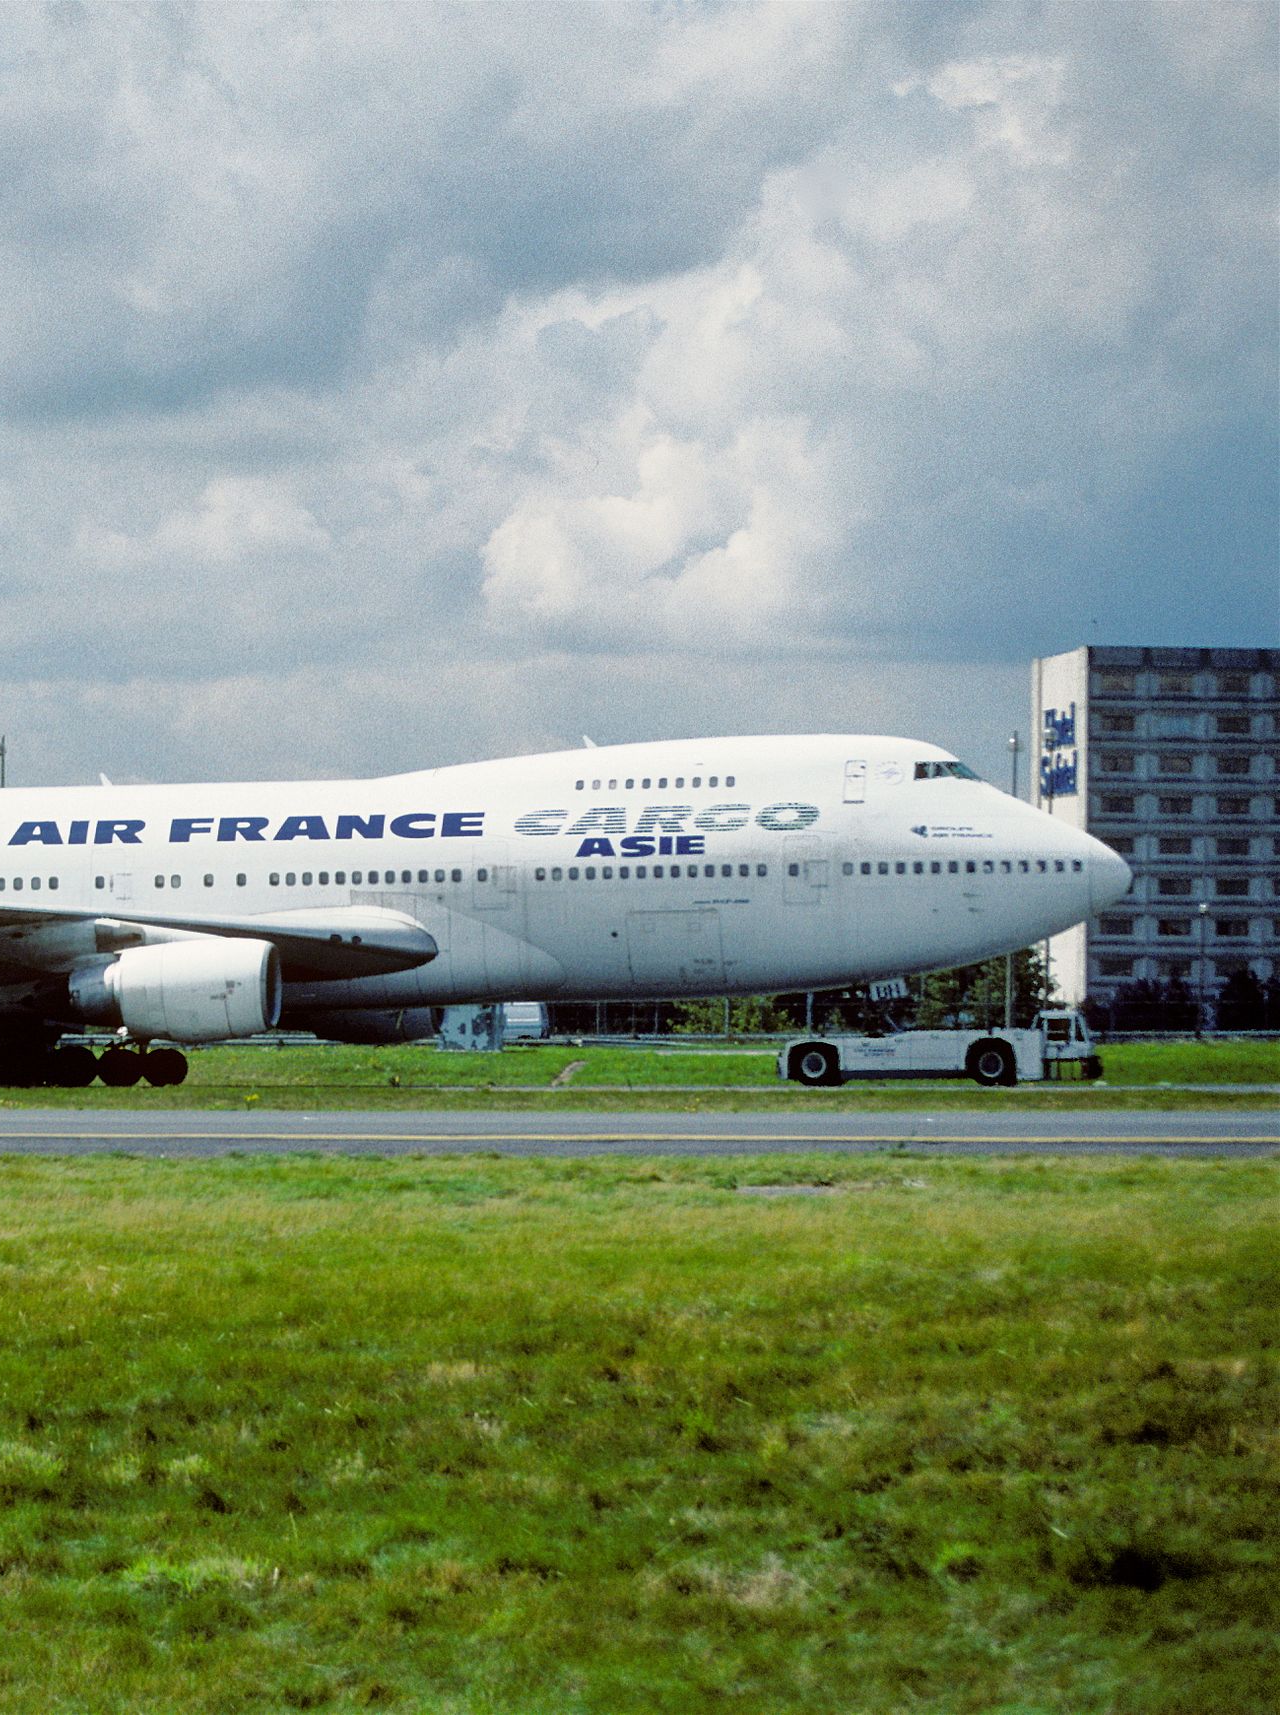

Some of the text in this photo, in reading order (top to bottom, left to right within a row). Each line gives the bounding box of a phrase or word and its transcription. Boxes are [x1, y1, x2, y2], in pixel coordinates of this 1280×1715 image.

[7, 802, 821, 846] AIR FRANCE CARGO
[575, 835, 706, 857] ASIE
